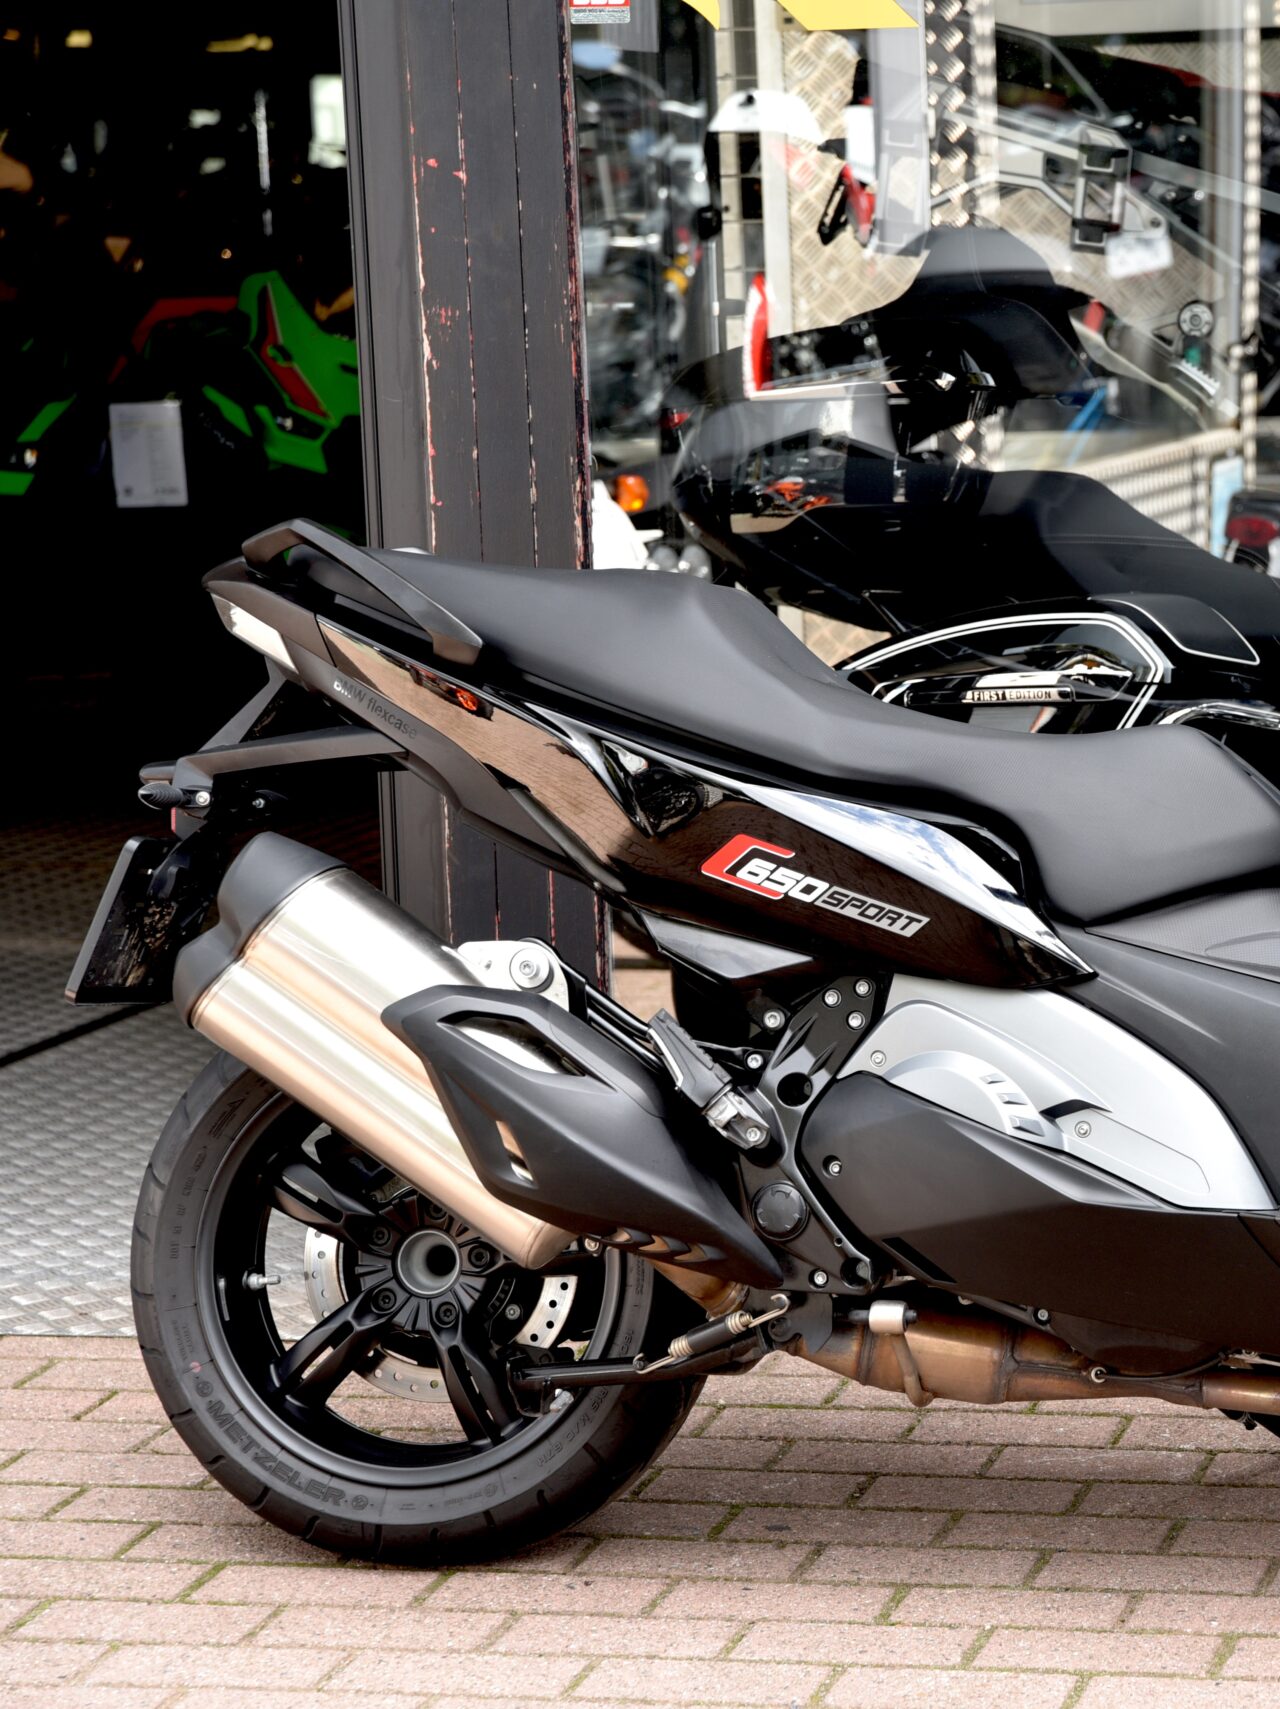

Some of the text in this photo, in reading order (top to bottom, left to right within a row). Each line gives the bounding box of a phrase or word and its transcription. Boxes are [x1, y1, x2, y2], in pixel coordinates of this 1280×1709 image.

[333, 679, 418, 740] BMW flexcase
[973, 689, 1052, 701] FIRST EDITION
[819, 888, 925, 935] SPORT
[205, 1399, 346, 1507] METZELER
